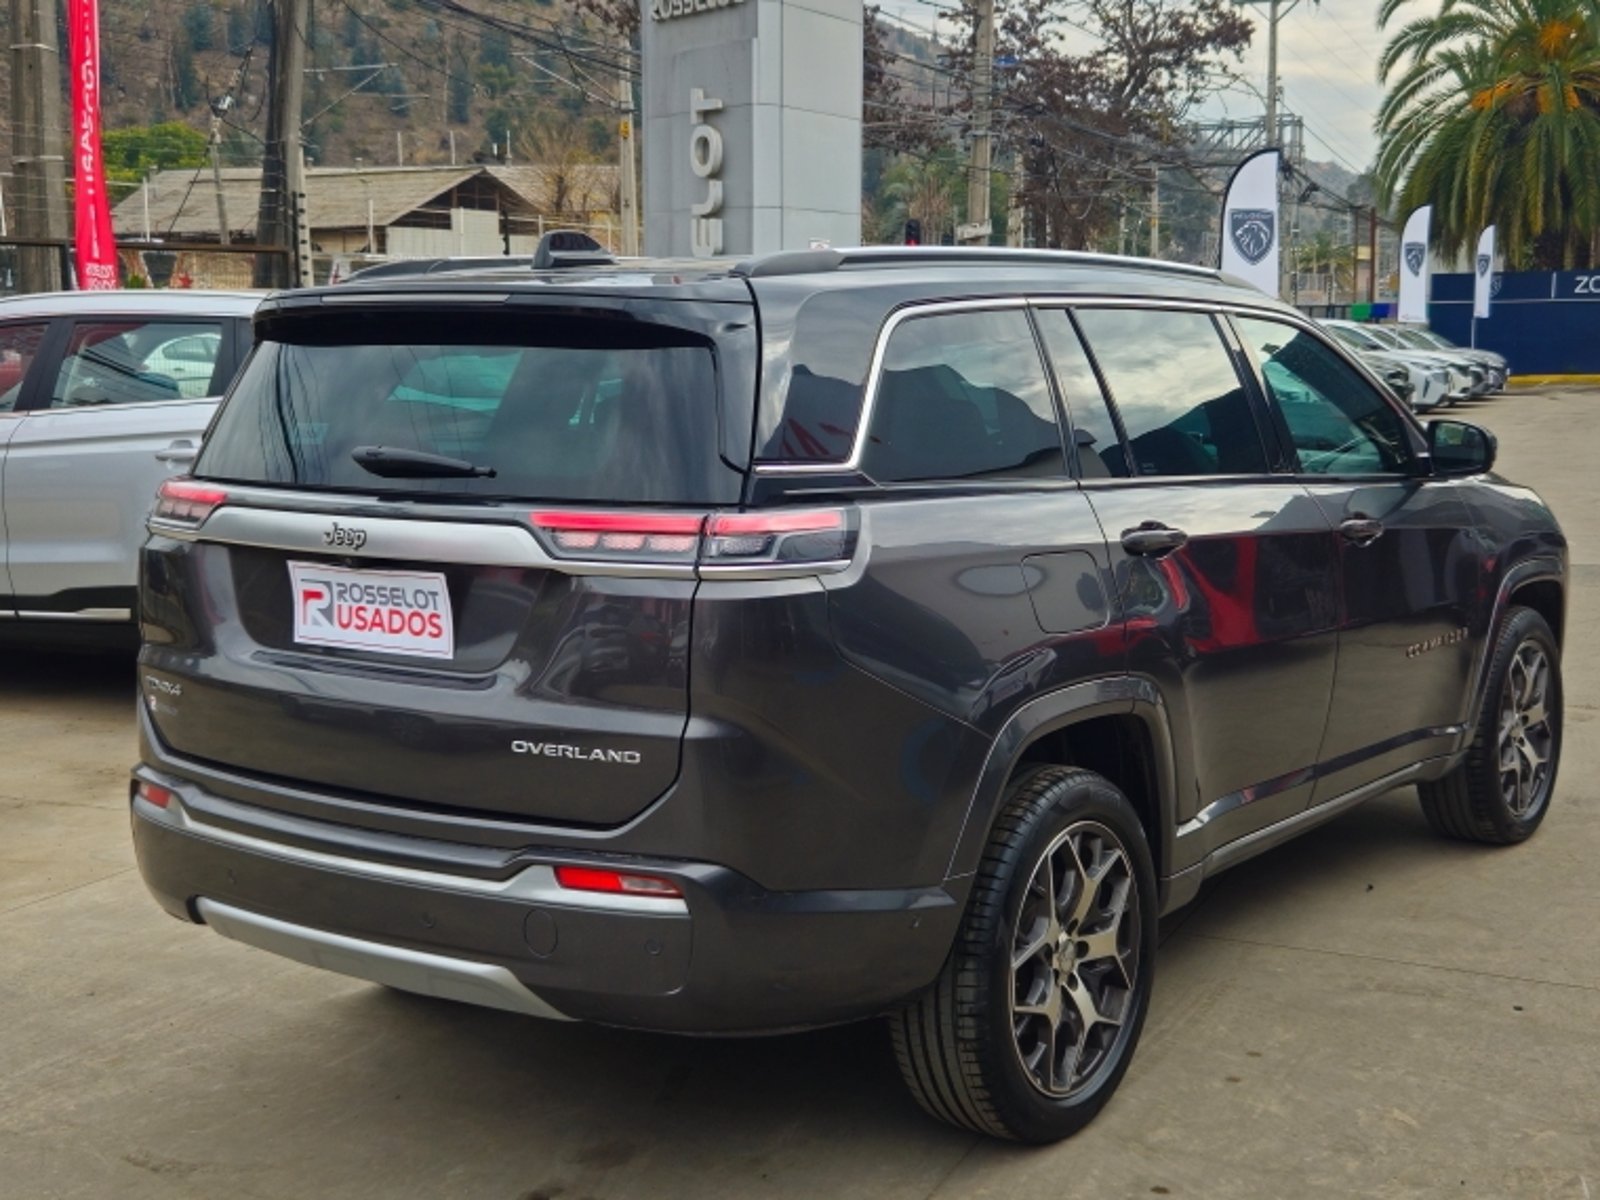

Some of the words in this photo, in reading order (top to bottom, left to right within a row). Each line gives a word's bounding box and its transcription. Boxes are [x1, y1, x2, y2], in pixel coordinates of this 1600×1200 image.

[323, 522, 367, 550] Jeep
[336, 582, 440, 611] ROSSELOT
[337, 605, 443, 639] USADOS
[510, 740, 641, 764] OVERLAND
